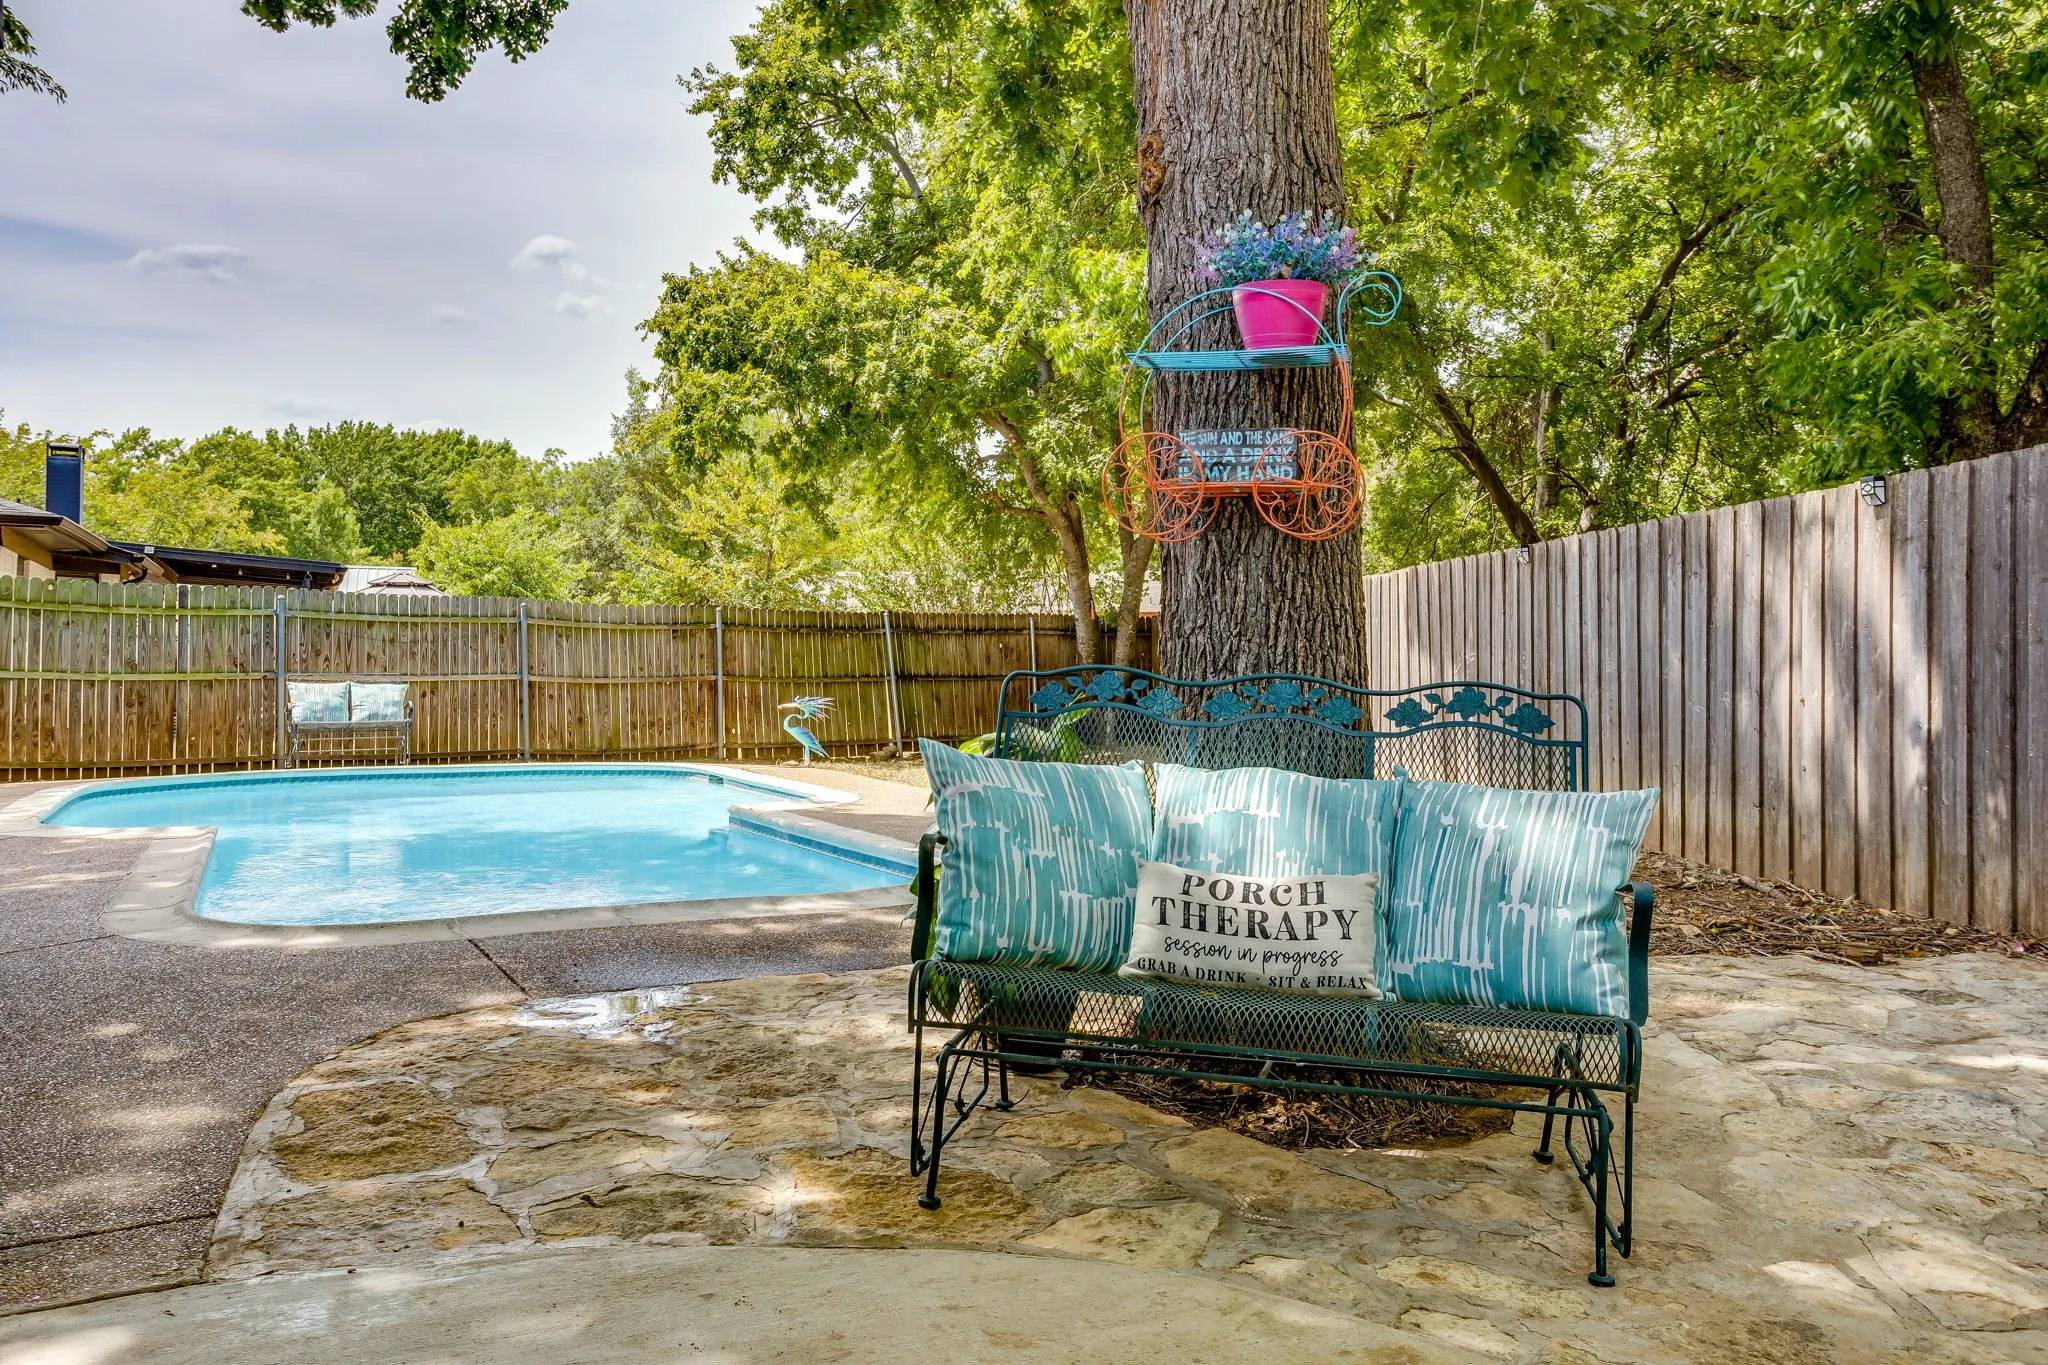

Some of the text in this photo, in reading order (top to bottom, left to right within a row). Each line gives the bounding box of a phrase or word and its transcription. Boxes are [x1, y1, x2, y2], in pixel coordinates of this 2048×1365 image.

[1179, 430, 1294, 446] THE SUN AND THE SAND
[1222, 447, 1237, 463] A
[1241, 447, 1293, 463] DRINK
[1204, 465, 1232, 481] MY
[1237, 465, 1293, 481] HAND
[1178, 873, 1328, 907] PORCH
[1152, 896, 1359, 941] THERAPY
[1164, 936, 1343, 977] session in progress
[1137, 957, 1367, 990] GRAB A DRINK SIT & RELAX
